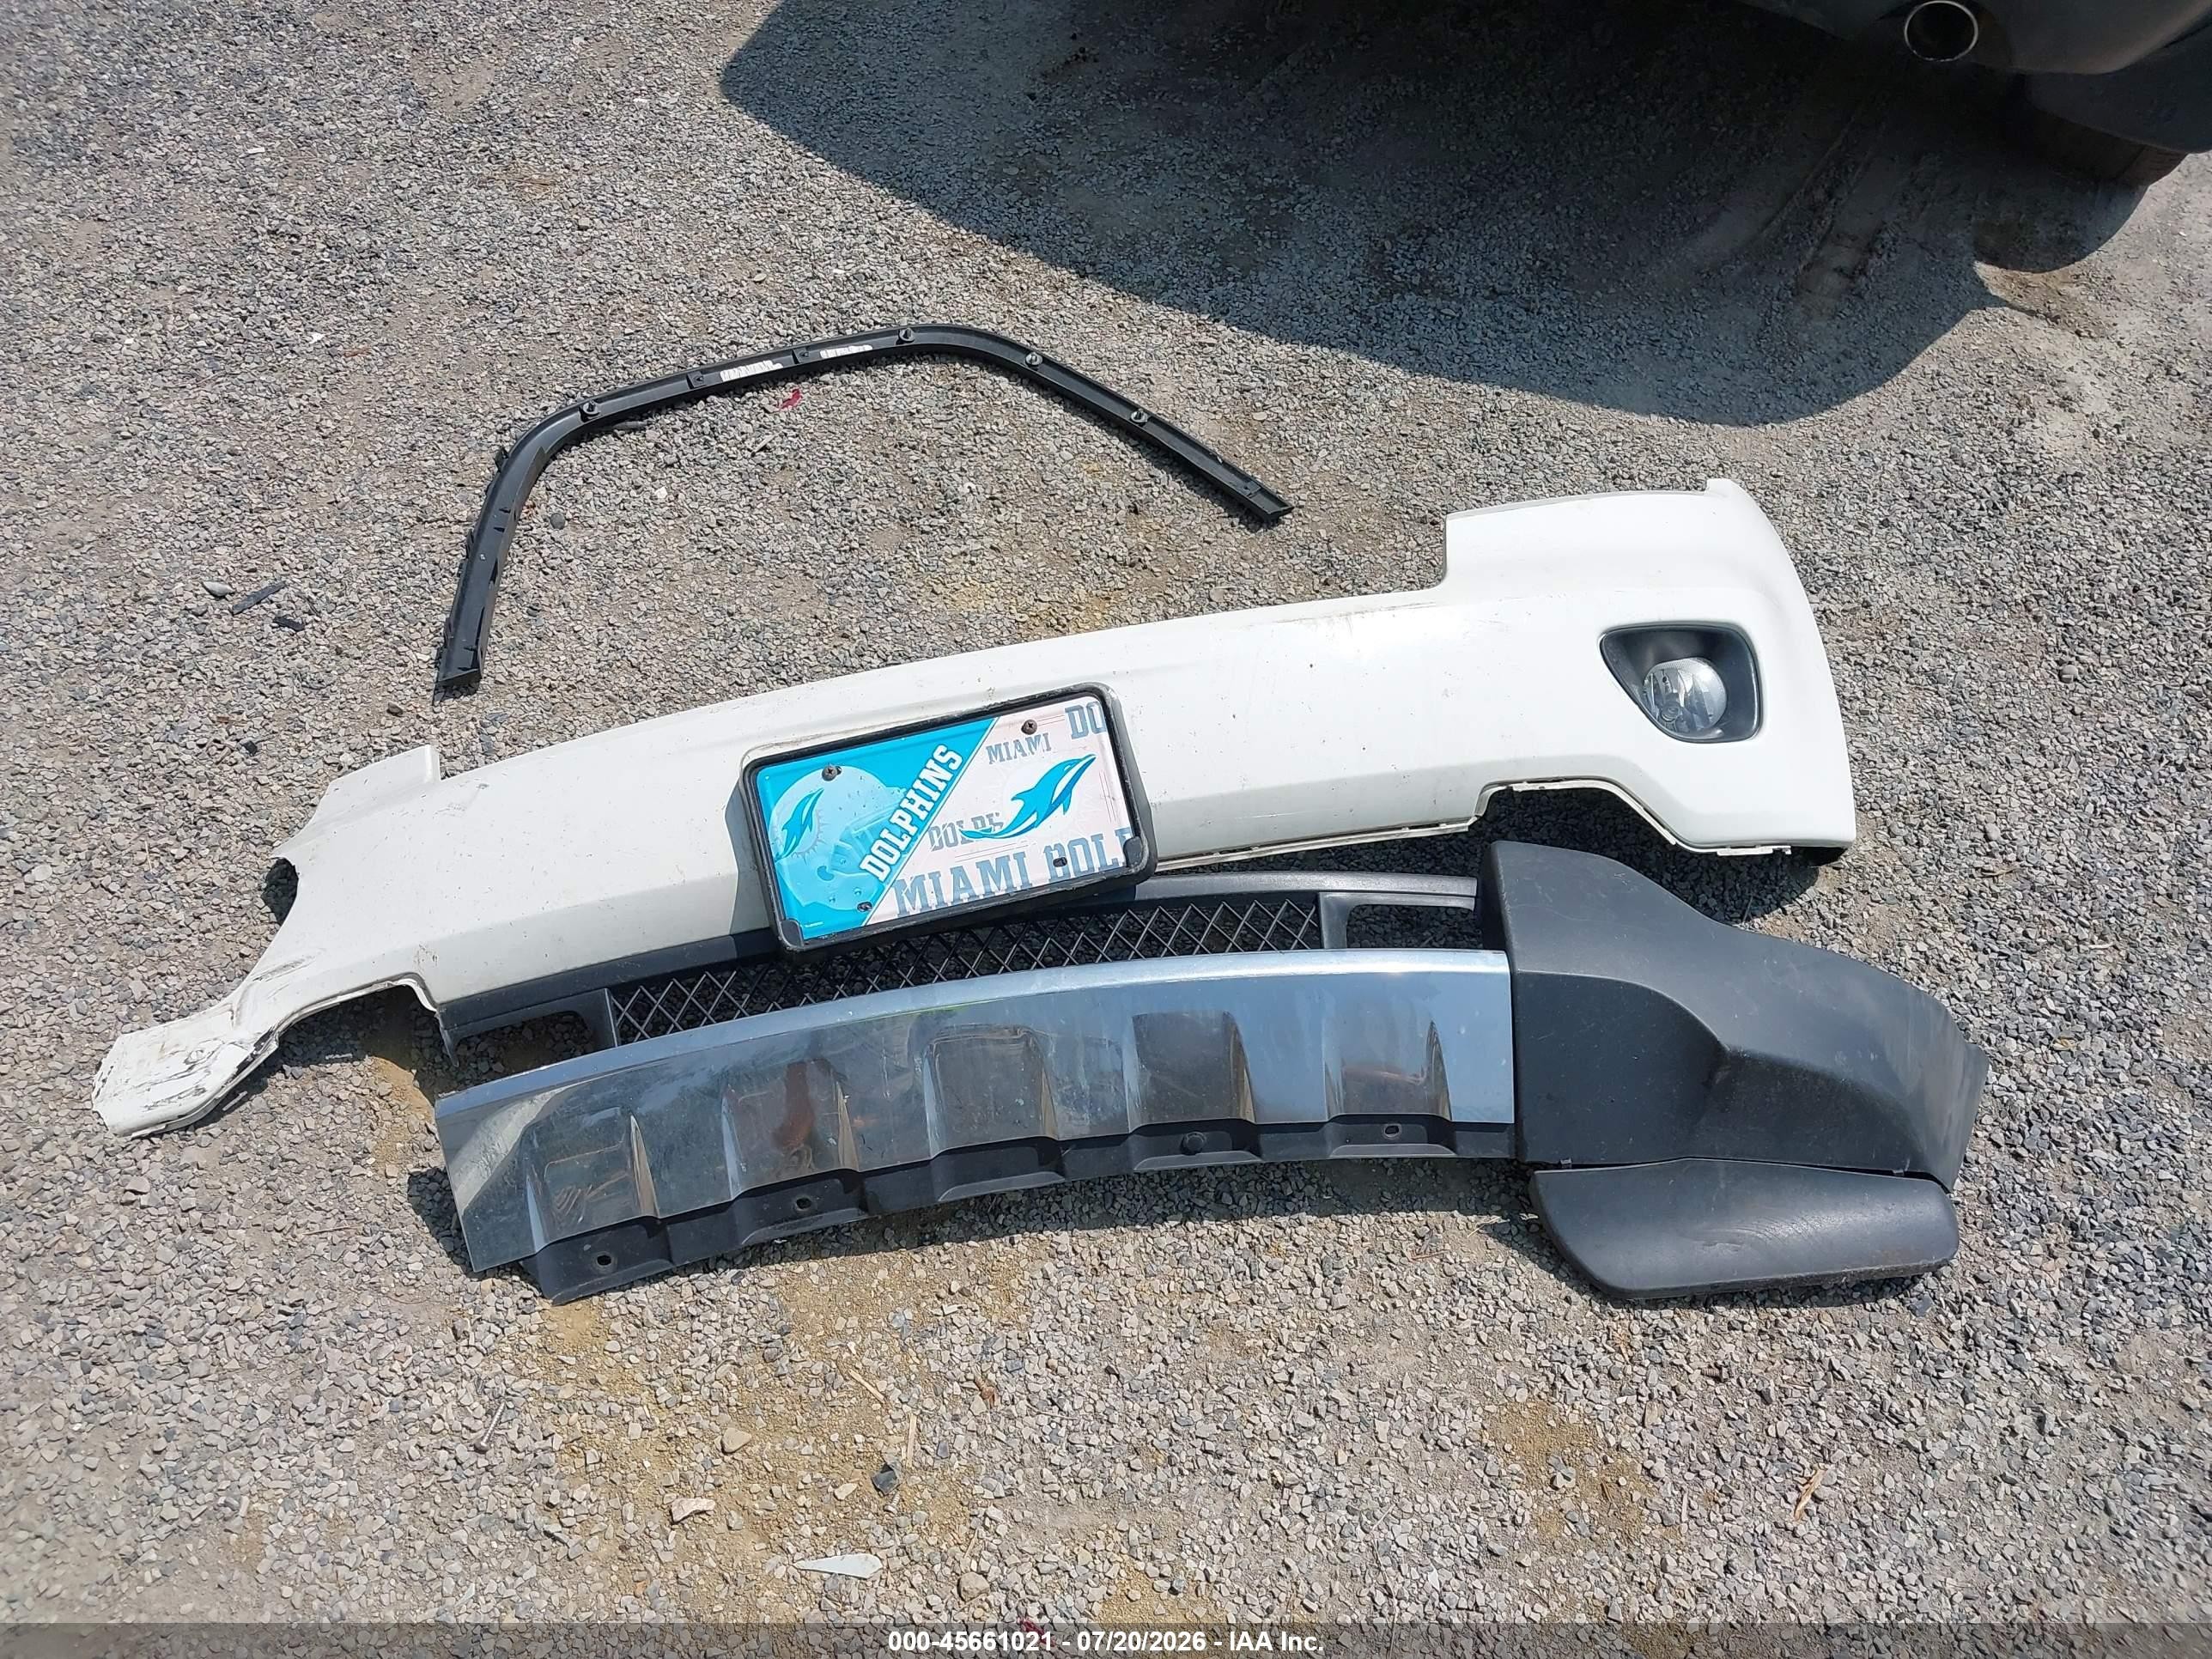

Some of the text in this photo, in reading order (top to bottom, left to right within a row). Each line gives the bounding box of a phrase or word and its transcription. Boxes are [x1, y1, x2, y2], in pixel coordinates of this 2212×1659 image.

[986, 732, 1052, 764] MIAMI
[860, 744, 963, 883] DOLPHINS
[893, 851, 1033, 918] MIAMI
